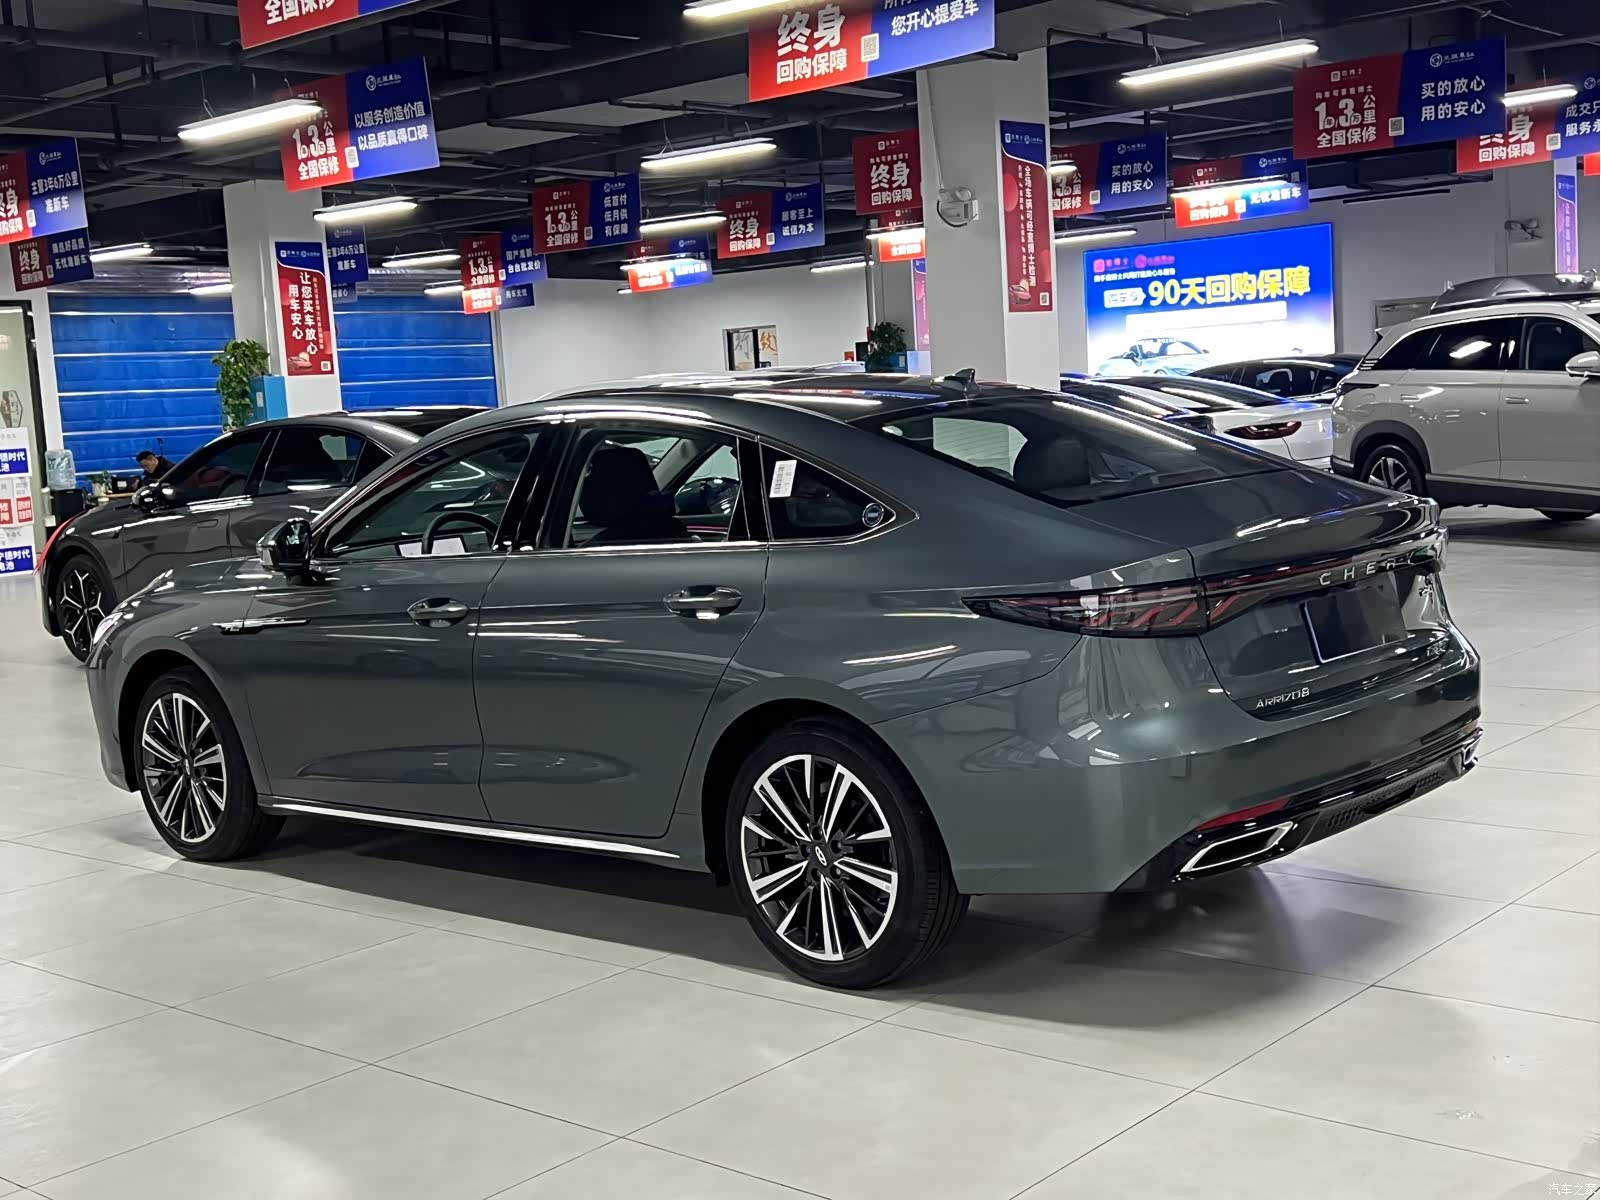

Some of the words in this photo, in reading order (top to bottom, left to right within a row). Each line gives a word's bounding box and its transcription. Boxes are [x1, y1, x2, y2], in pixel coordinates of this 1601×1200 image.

[891, 0, 979, 36] 您开心提爱车
[777, 4, 846, 57] 终身
[776, 48, 848, 84] 回购保障
[1420, 75, 1486, 100] 买的放心
[354, 101, 426, 129] 以服务创造价值
[1420, 98, 1486, 122] 用的安心
[358, 124, 429, 151] 以品质赢得口碑
[1316, 126, 1377, 149] 全国保修
[1479, 141, 1536, 163] 回购保障
[298, 155, 341, 180] 全国保修
[870, 161, 910, 190] 终身
[1111, 160, 1153, 178] 买的放心
[871, 188, 913, 206] 回购保障
[1111, 178, 1153, 194] 用的安心
[45, 196, 70, 213] 准新车
[604, 193, 627, 208] 低首付
[604, 208, 628, 222] 低月供
[781, 208, 814, 222] 顾客至上
[546, 232, 579, 247] 全国保修
[605, 223, 628, 237] 有保障
[729, 217, 759, 239] 终身
[782, 223, 815, 236] 诚信为本
[729, 238, 761, 252] 回购保障
[19, 248, 40, 272] 终身
[1149, 265, 1311, 307] 90天回购保障
[288, 284, 304, 340] 用车安心
[300, 272, 318, 355] 让您买车放心
